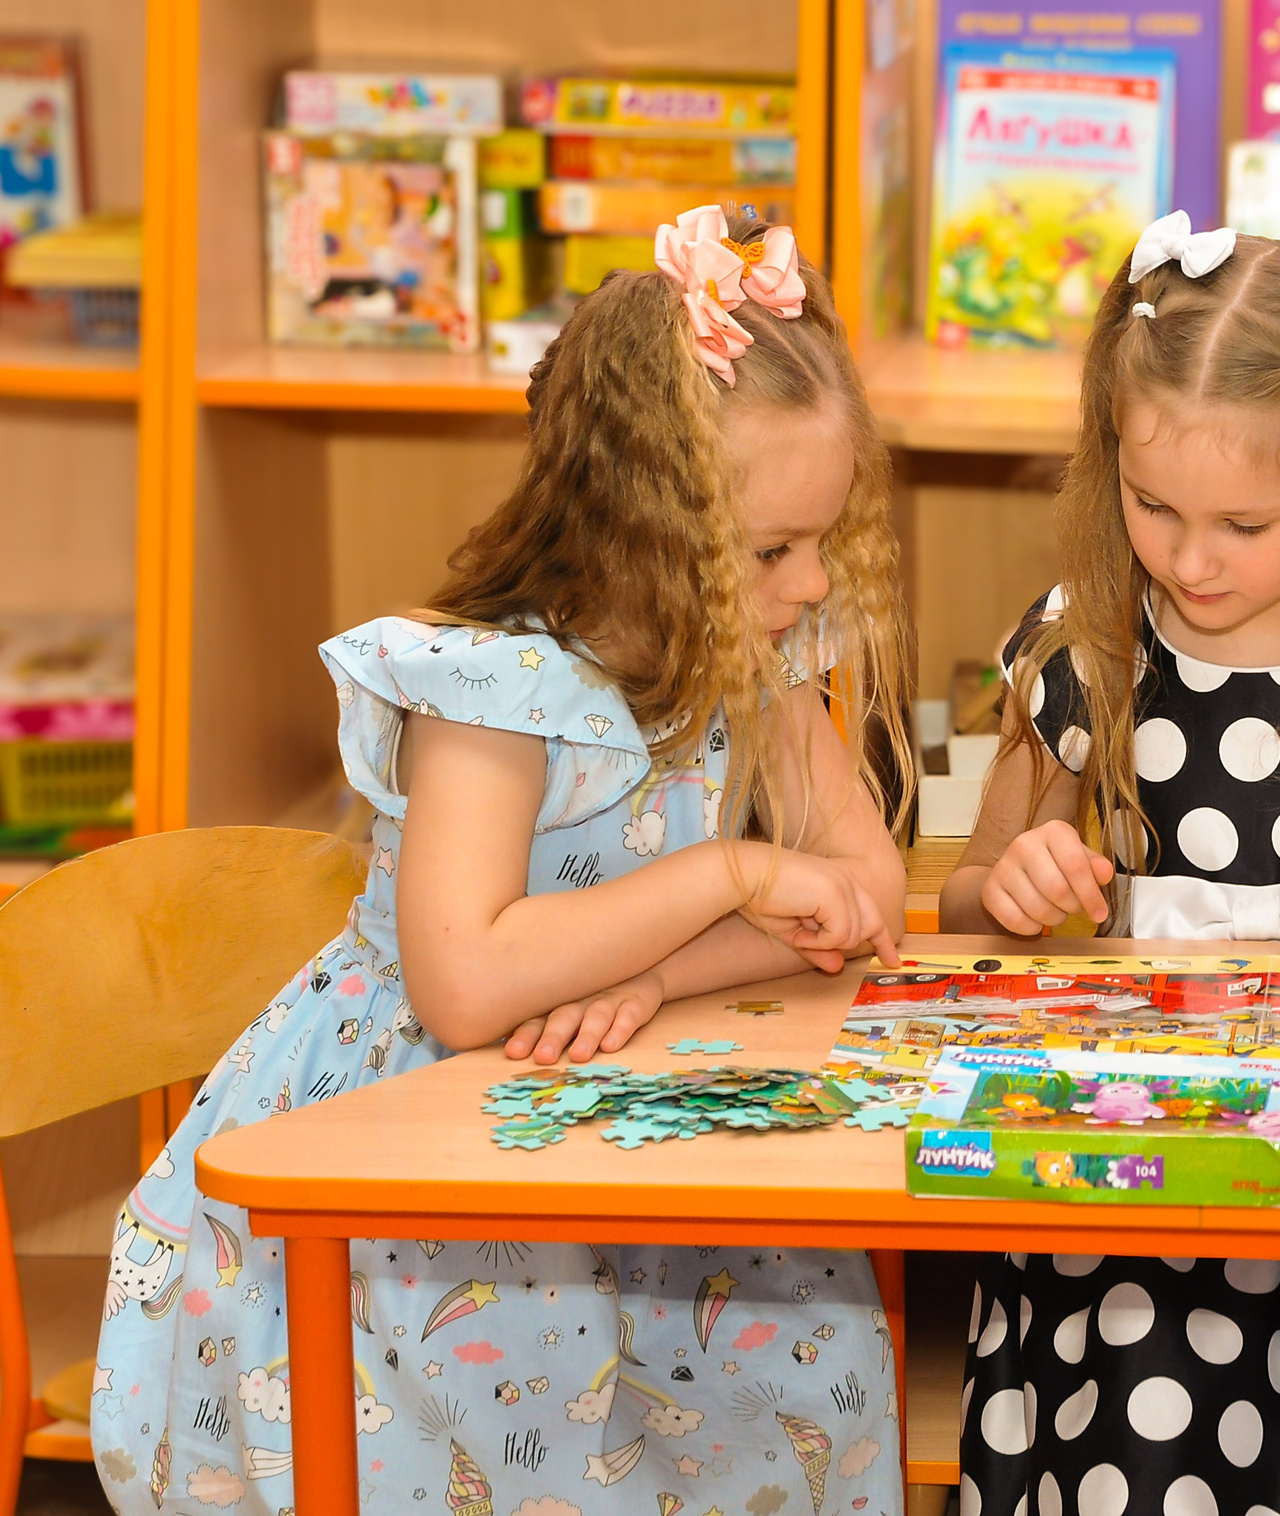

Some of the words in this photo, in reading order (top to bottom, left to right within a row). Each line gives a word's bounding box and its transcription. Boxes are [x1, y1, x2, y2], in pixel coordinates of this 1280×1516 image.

[556, 851, 604, 888] Hello
[953, 1053, 1052, 1068] ЛУНТИК
[916, 1146, 995, 1169] ЛУНТИК
[1135, 1165, 1157, 1178] 104
[830, 1370, 867, 1416] Hello
[193, 1395, 231, 1442] Hello
[504, 1427, 550, 1472] Hello
